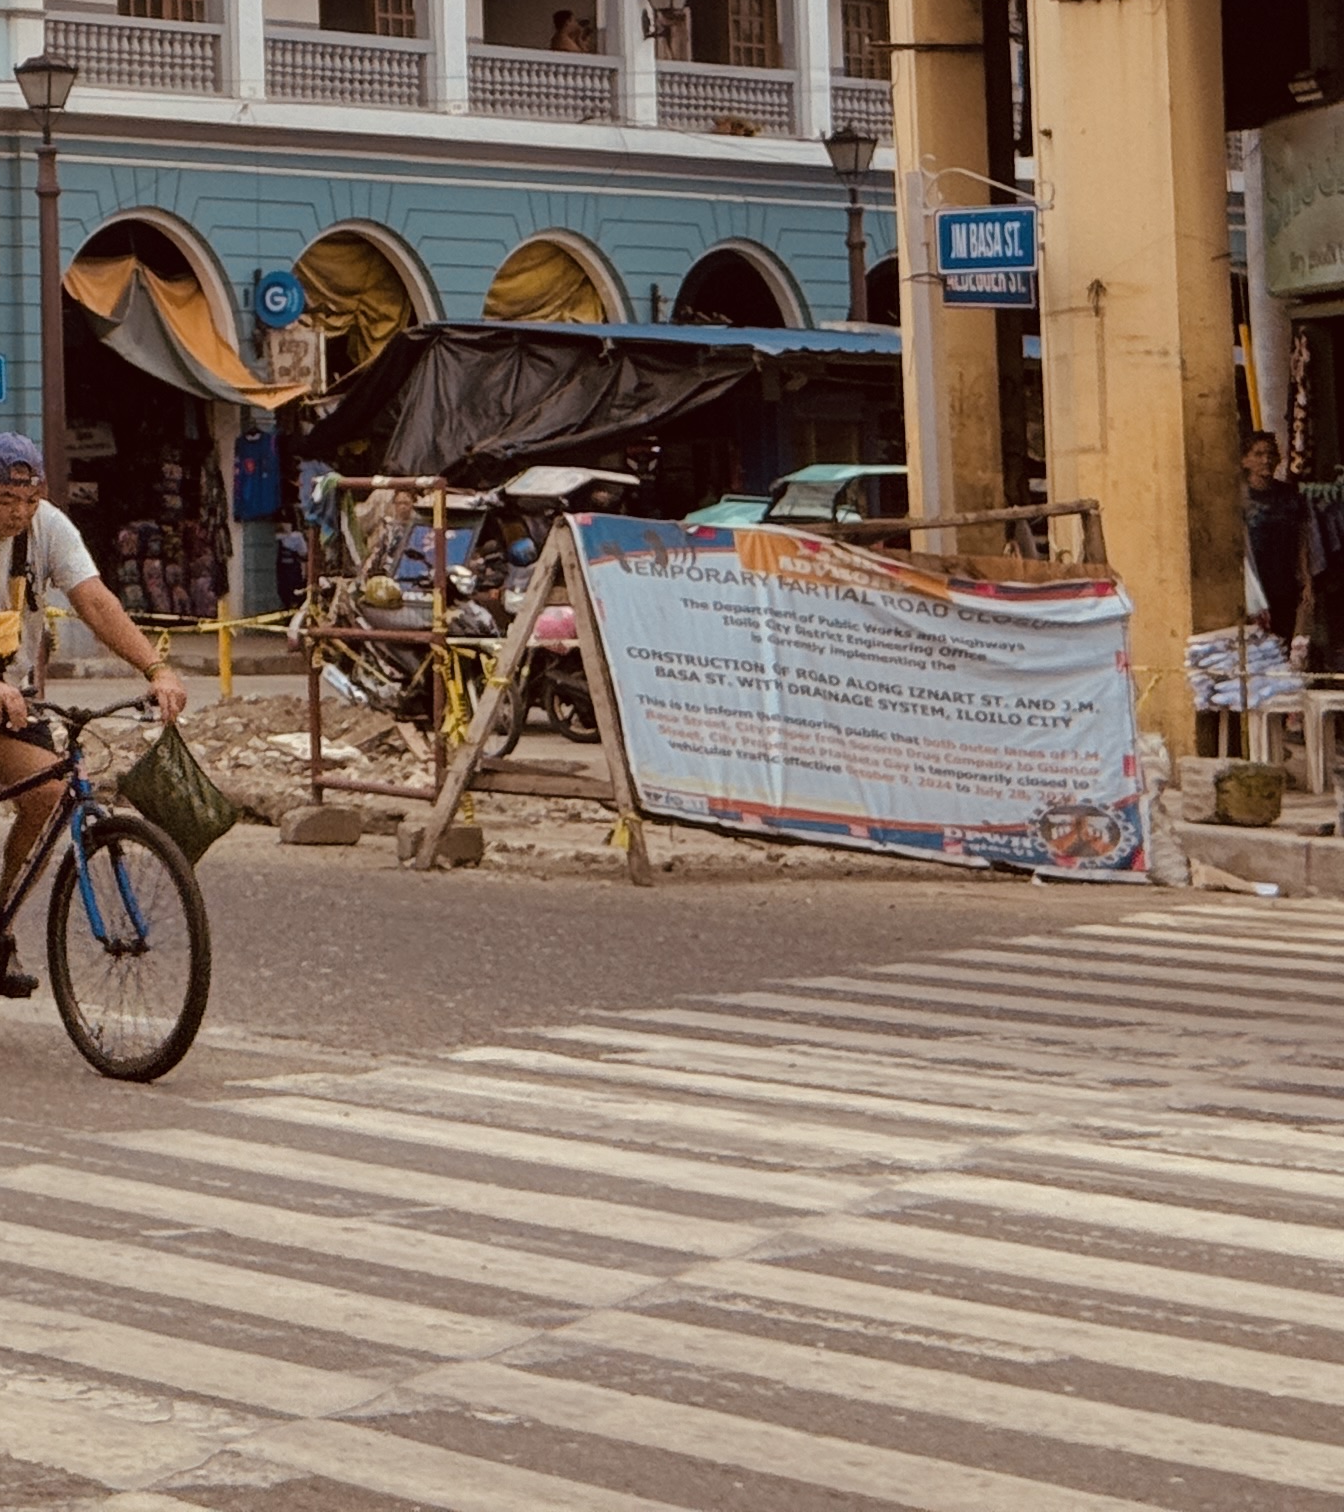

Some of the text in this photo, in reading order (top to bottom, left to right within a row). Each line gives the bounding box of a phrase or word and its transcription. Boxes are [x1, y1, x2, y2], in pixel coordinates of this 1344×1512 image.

[950, 221, 1024, 259] JM BASA ST.
[680, 598, 709, 610] The
[818, 616, 860, 633] Public
[863, 621, 912, 639] Works
[881, 596, 949, 619] ROAD
[796, 623, 843, 643] District
[846, 632, 933, 658] Engineering
[938, 646, 987, 663] Office
[830, 645, 927, 672] implementing
[931, 658, 957, 673] the
[626, 646, 766, 676] CONSTRUCTION
[795, 668, 841, 687] ROAD
[846, 676, 904, 697] ALONG
[908, 686, 975, 707] IZNART
[980, 694, 1009, 709] ST.
[1015, 696, 1056, 712] AND
[655, 665, 1073, 729] BASA ST. WITH DRAINAGE SYSTEM, ILOILO CITY
[637, 694, 666, 708] This
[670, 699, 682, 711] is
[685, 702, 701, 714] to
[704, 703, 753, 720] inform
[845, 725, 888, 741] public
[891, 732, 920, 746] that
[929, 766, 1011, 786] temporarily
[1017, 775, 1068, 789] closed
